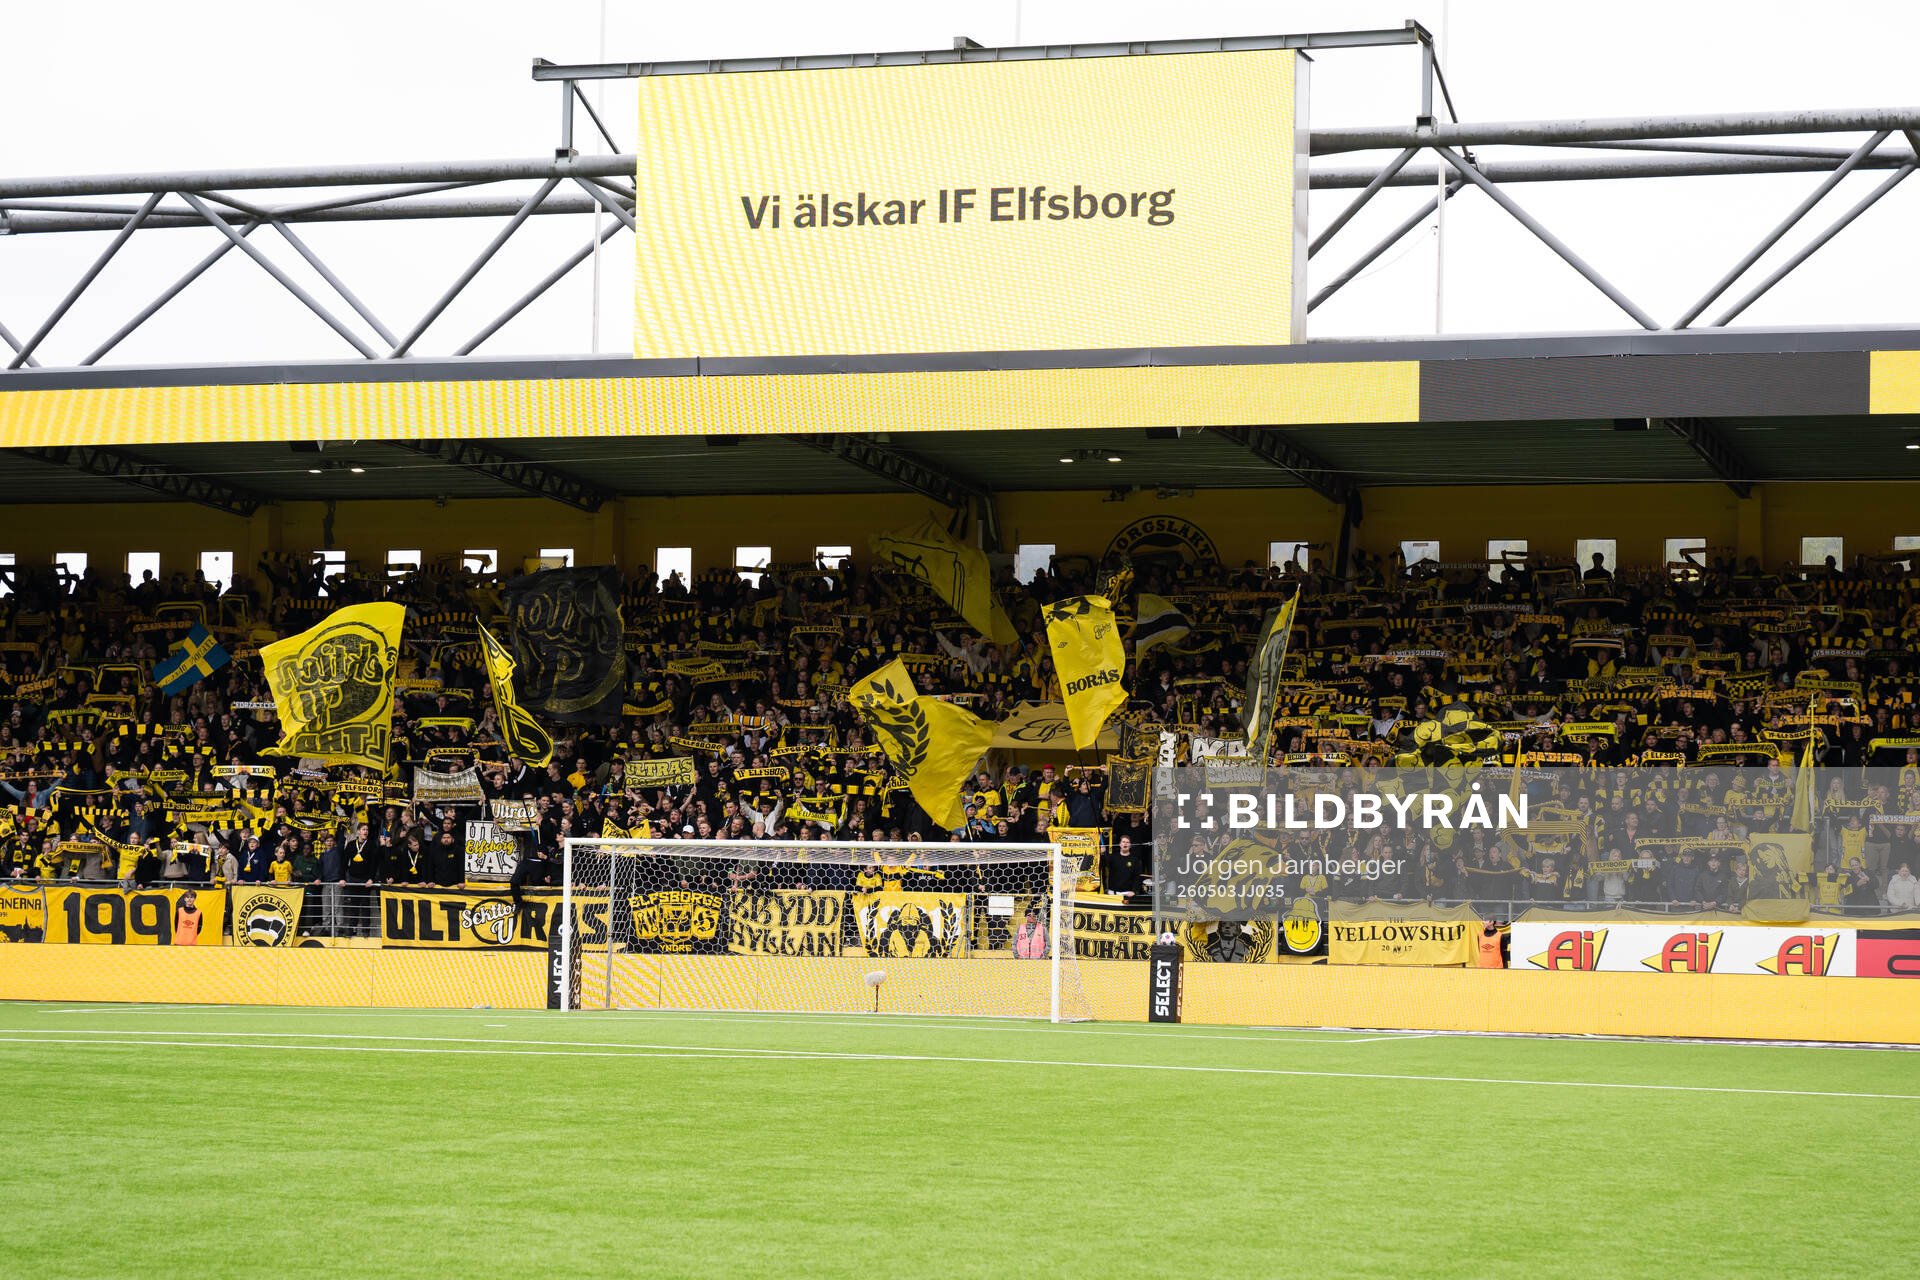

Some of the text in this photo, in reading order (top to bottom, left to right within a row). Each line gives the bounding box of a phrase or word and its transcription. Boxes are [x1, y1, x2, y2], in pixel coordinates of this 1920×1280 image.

[741, 184, 1176, 230] Vi älskar IF Elfsborg
[1114, 519, 1214, 557] ORGSLÄKT
[1065, 668, 1122, 696] BORÅS
[252, 766, 271, 775] KLAS
[625, 759, 693, 777] ULTRAS
[491, 802, 538, 819] Ultras
[802, 810, 830, 820] ELFSBORG
[465, 838, 518, 858] Elfsborg
[463, 852, 521, 875] RAS
[1596, 860, 1628, 869] ELFSBORG
[628, 890, 723, 909] ELFSBORGS
[63, 891, 204, 945] 199
[1060, 911, 1183, 937] OLLEKTIV
[491, 916, 514, 944] U
[1333, 924, 1466, 942] YELLOWSHIP
[659, 943, 692, 953] YNGRE
[1155, 959, 1171, 1017] SELECT
